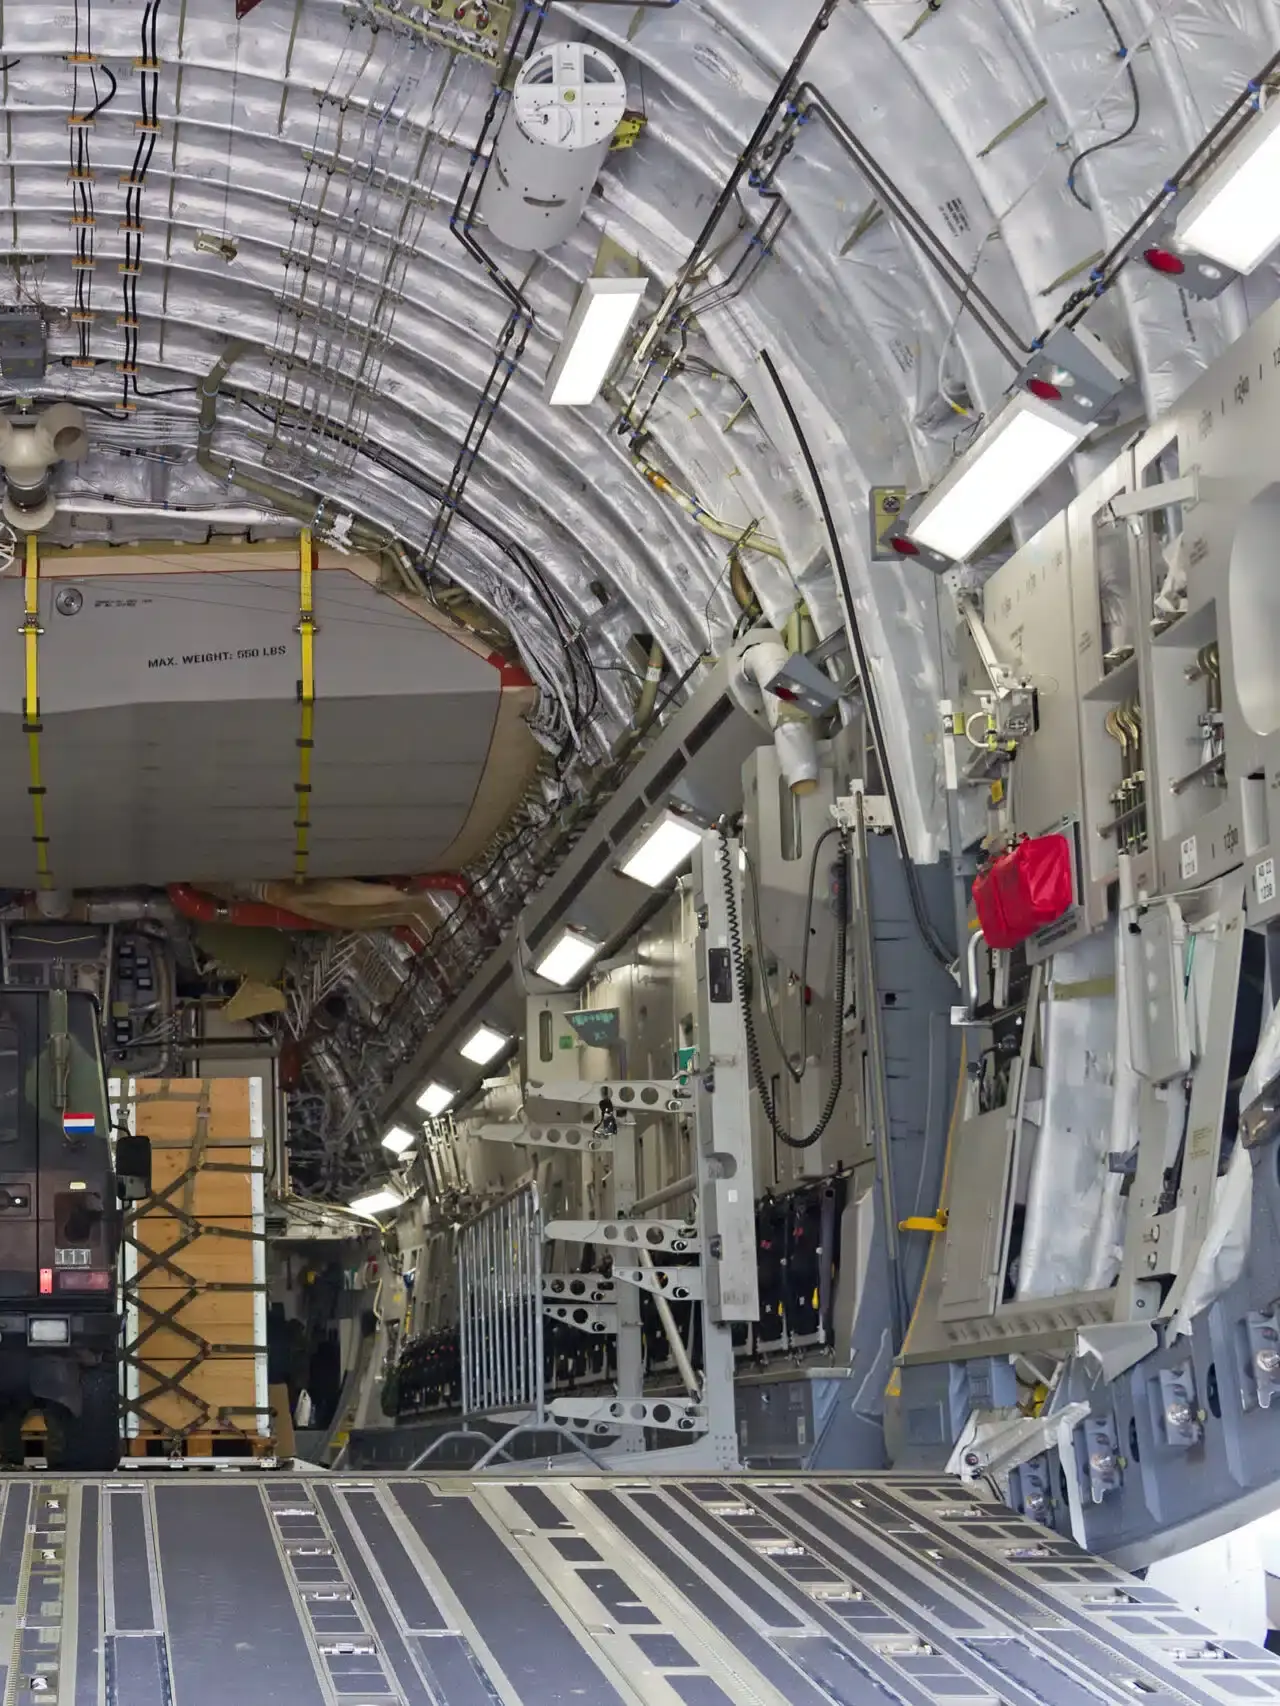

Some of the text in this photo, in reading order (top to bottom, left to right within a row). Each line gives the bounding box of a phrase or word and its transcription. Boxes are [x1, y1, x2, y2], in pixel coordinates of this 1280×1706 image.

[148, 645, 286, 669] MAX. WEIGHT: 550 LBS
